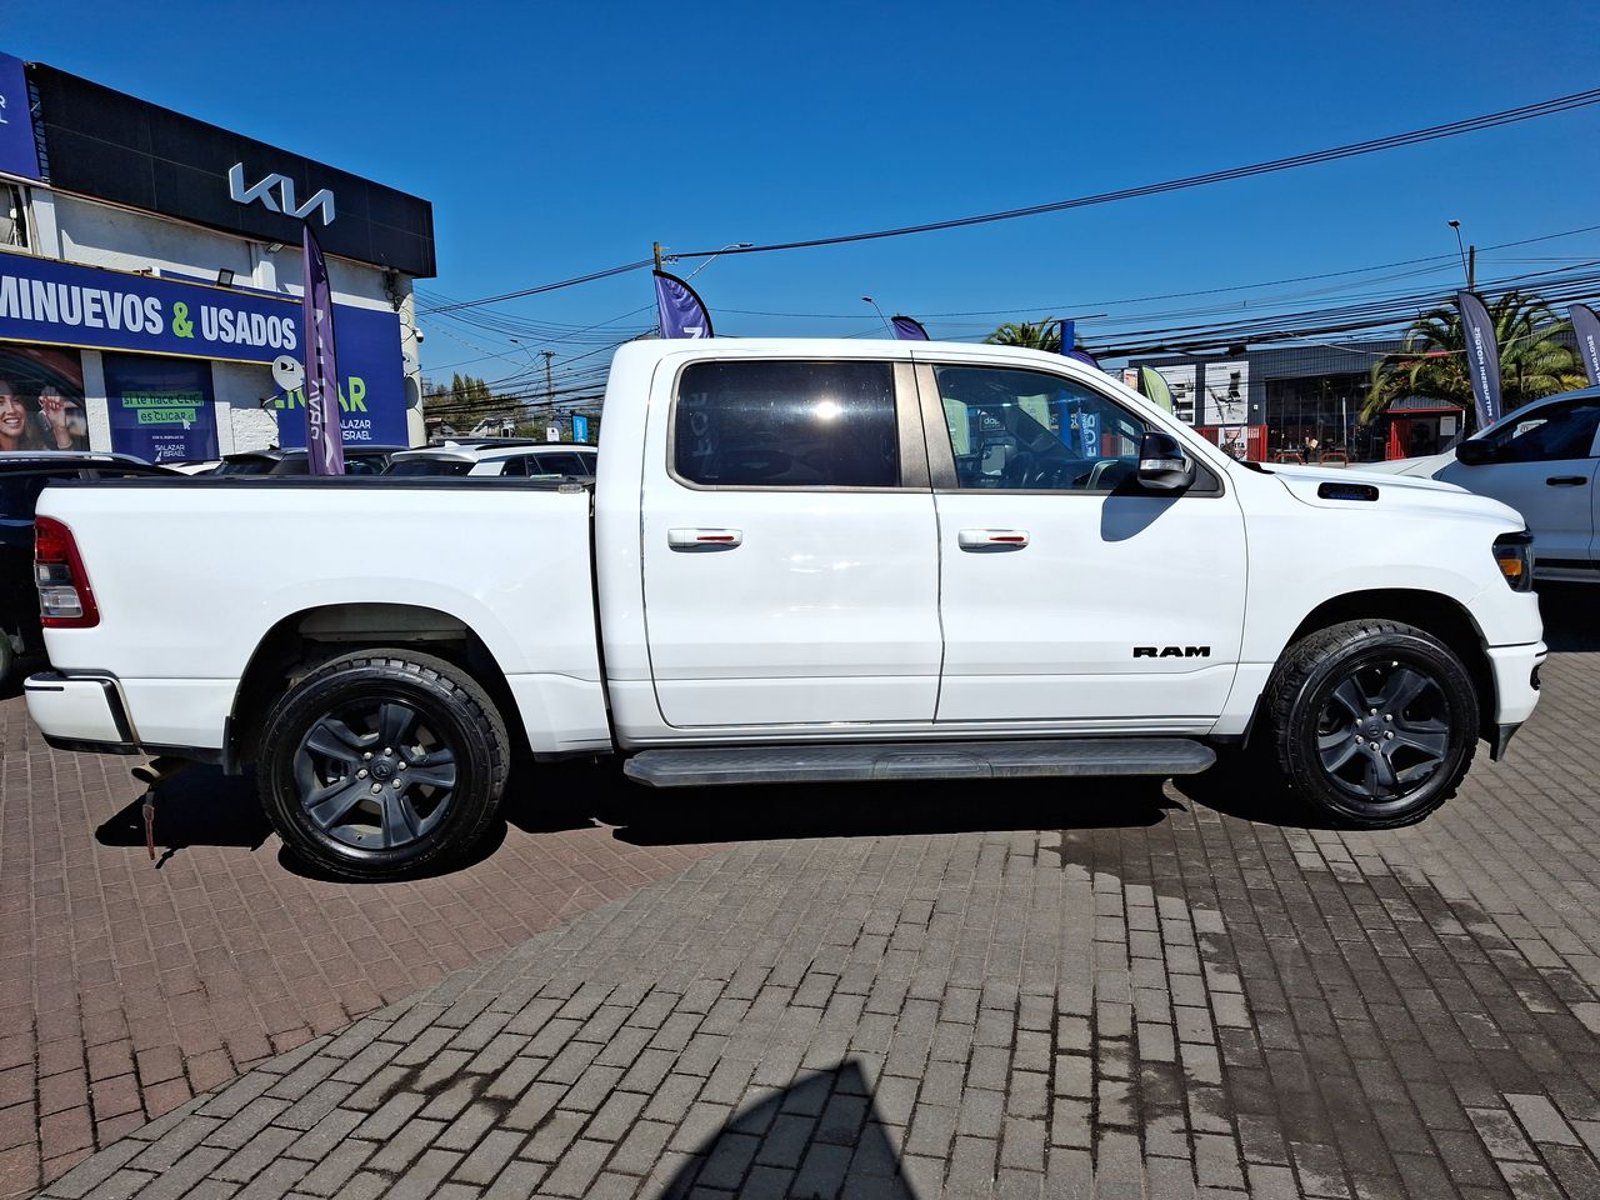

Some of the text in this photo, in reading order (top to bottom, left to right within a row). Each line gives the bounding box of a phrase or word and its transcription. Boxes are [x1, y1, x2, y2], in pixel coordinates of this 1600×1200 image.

[172, 302, 195, 338] &
[200, 305, 298, 351] USADOS
[342, 430, 372, 440] ISRAEL
[1133, 646, 1211, 658] RAM
